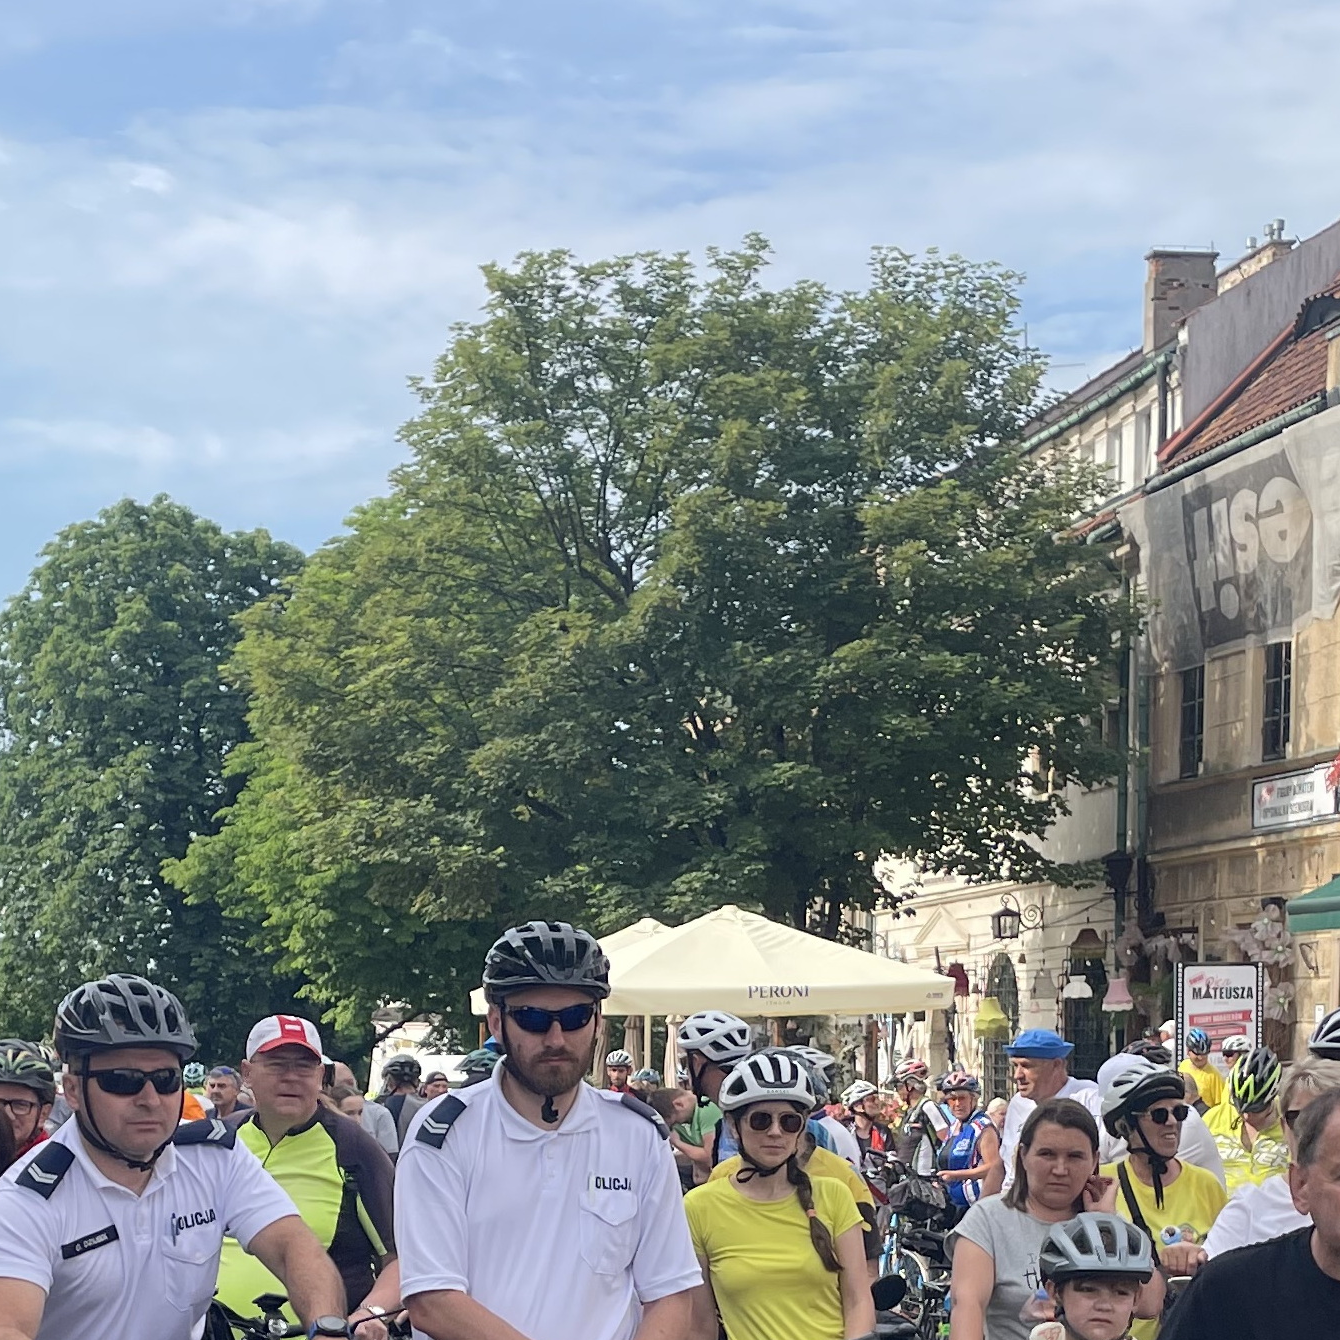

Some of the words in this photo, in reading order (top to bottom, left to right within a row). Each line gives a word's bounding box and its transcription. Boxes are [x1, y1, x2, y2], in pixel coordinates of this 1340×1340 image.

[747, 984, 810, 999] PERONI
[1192, 984, 1254, 1000] MATEUSZA
[594, 1176, 632, 1191] OLICJ
[173, 1208, 217, 1231] OLICJA
